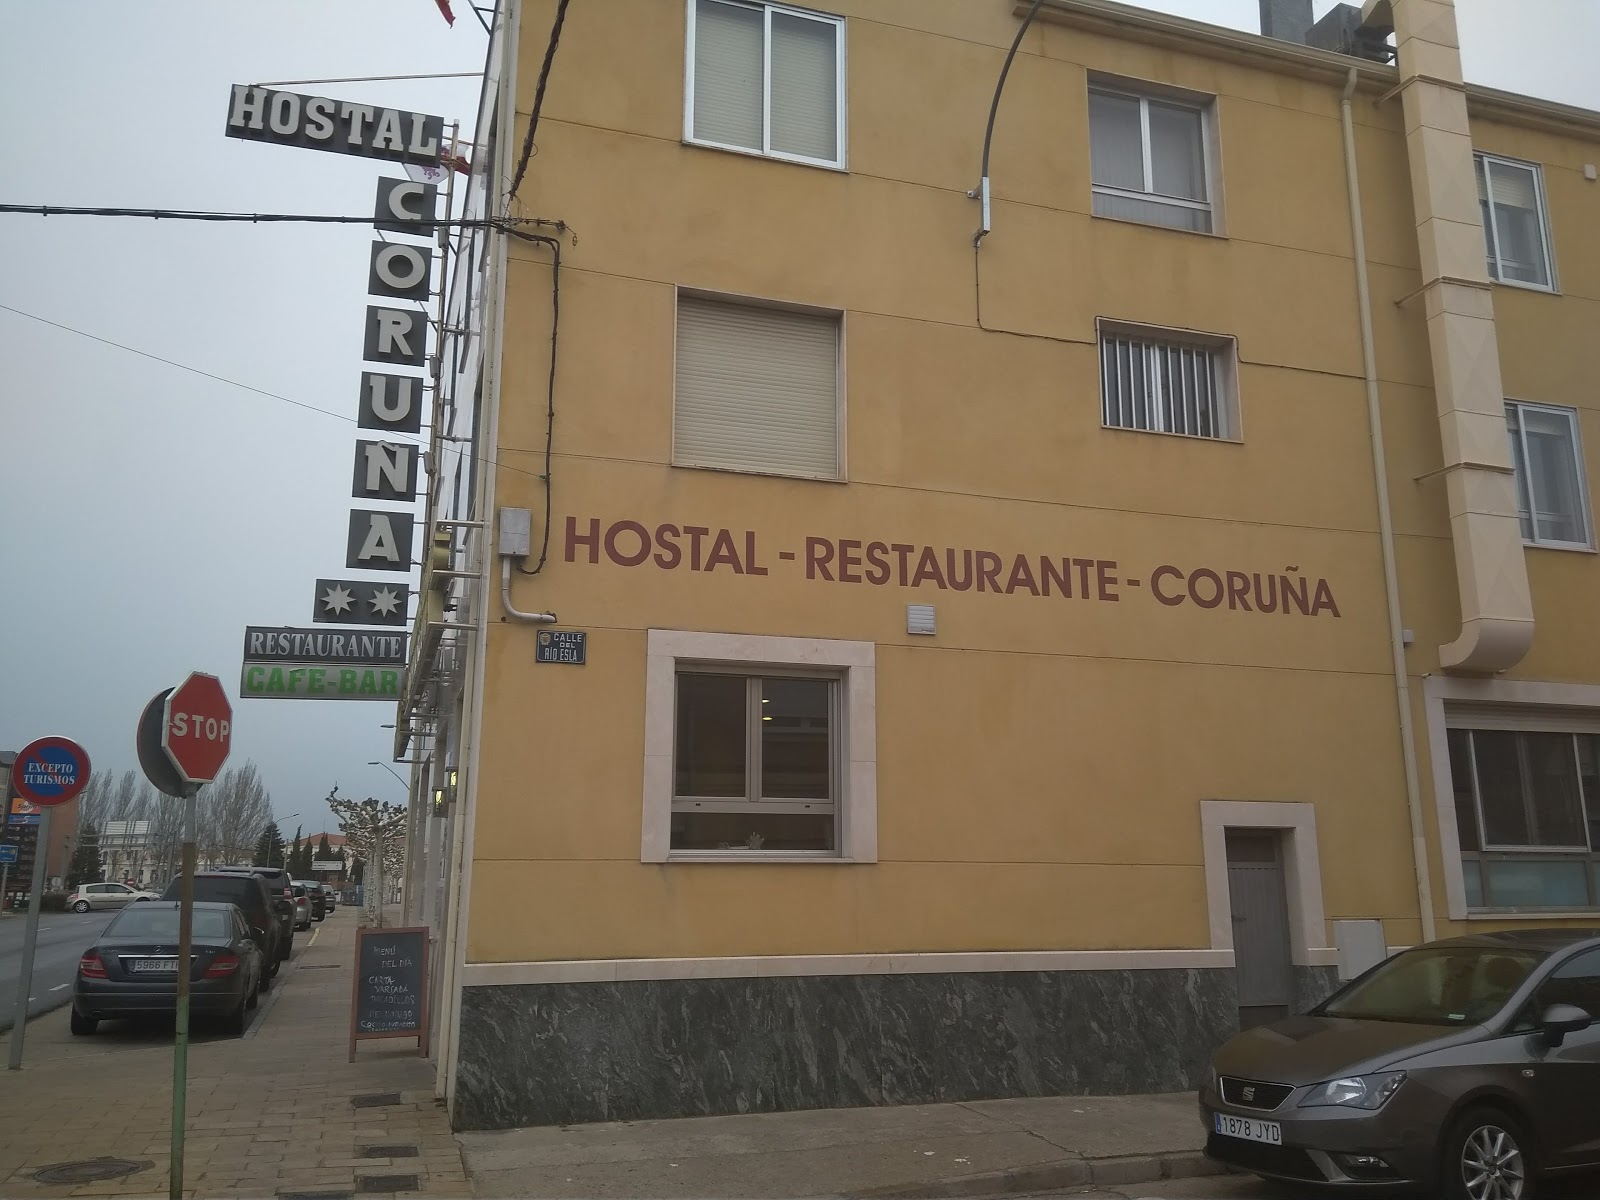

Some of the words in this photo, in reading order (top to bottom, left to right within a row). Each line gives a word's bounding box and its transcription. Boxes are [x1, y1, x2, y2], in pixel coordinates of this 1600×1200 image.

[229, 85, 437, 157] HOSTAL
[564, 516, 769, 576] HOSTAL
[806, 536, 1120, 602] RESTAURANTE
[1150, 564, 1341, 618] CORUÑA
[250, 632, 402, 658] RESTAURANTE
[553, 633, 582, 643] CALLE
[560, 648, 578, 661] ESLA
[246, 666, 399, 695] CAFE-BAR
[172, 712, 230, 742] STOP
[24, 774, 76, 785] TURISMOS
[28, 762, 74, 773] EXCEPTO
[136, 960, 161, 970] 5966
[1223, 1116, 1251, 1137] 1878
[1256, 1122, 1280, 1141] JYD
